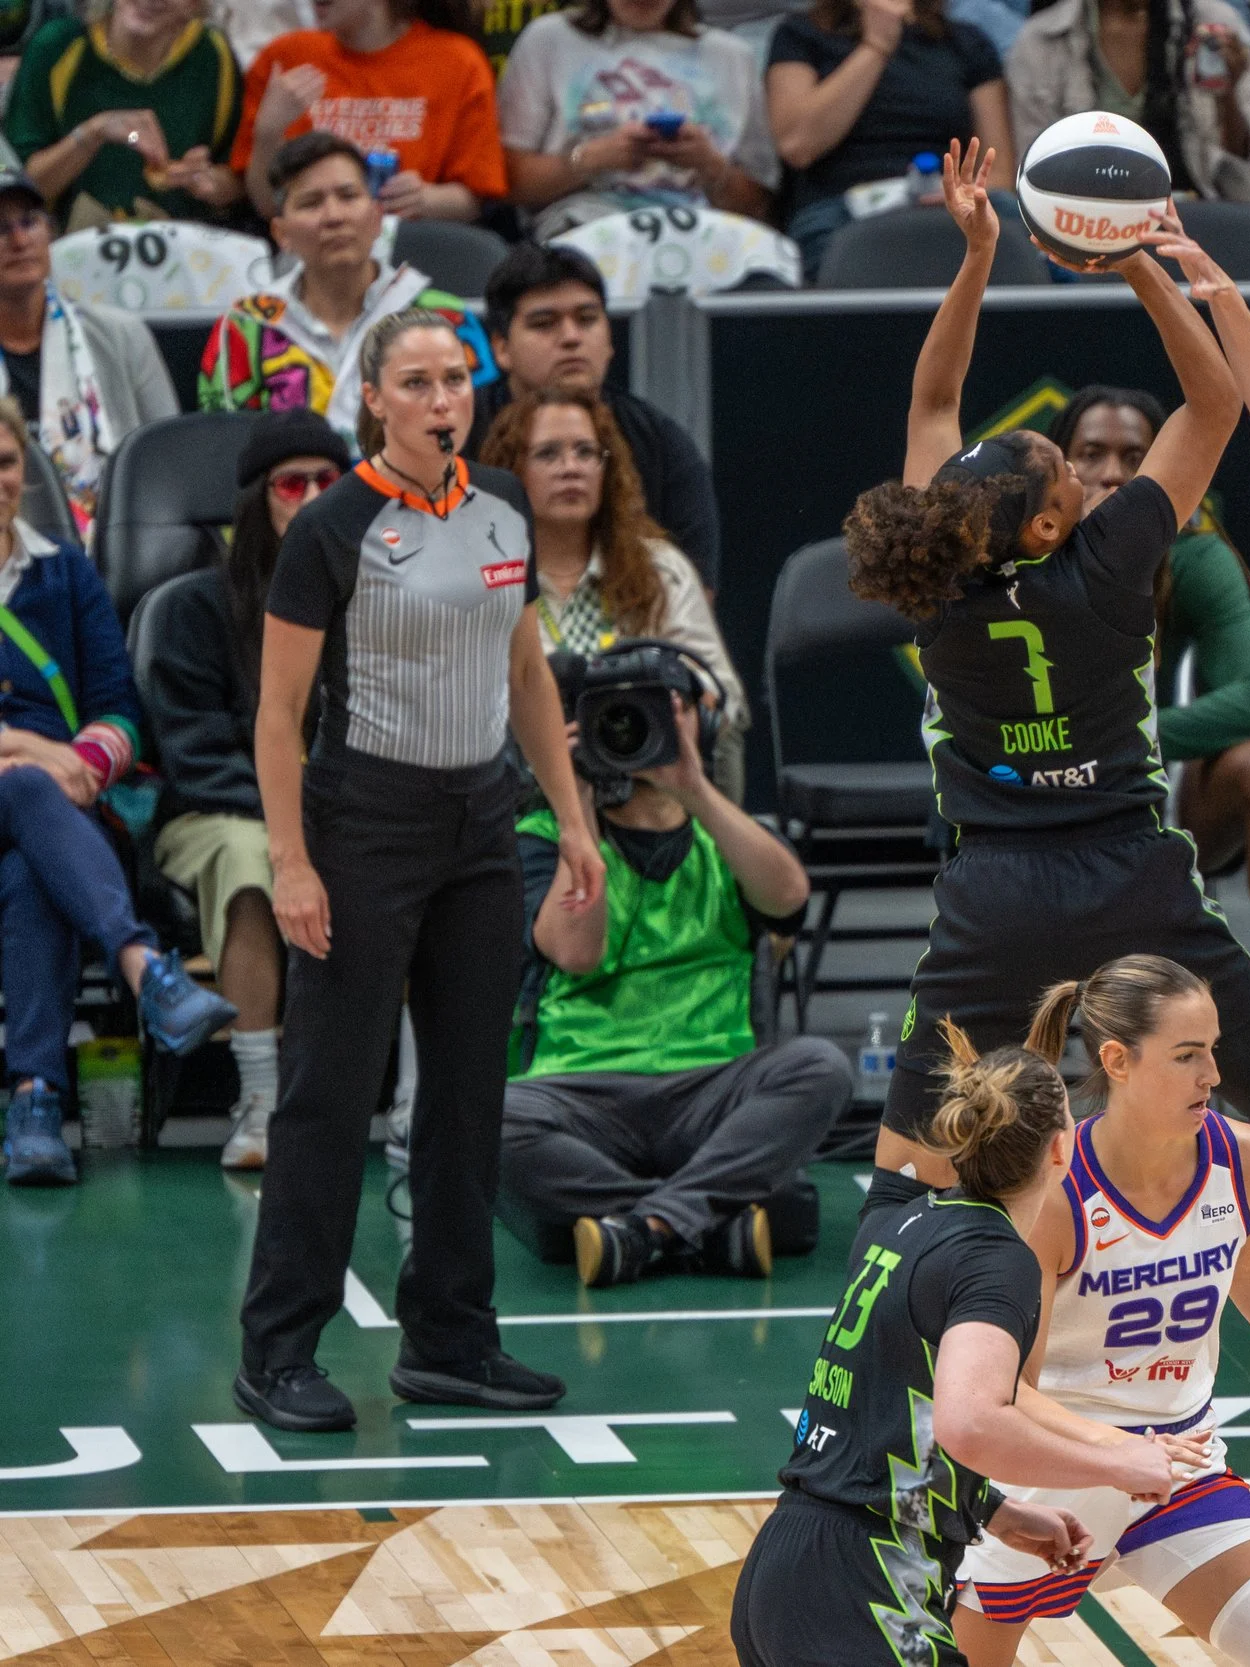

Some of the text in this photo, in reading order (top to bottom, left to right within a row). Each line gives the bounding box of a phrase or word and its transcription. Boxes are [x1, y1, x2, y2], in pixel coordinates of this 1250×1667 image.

[630, 206, 697, 242] 90
[1054, 206, 1151, 241] Wilson
[101, 231, 167, 274] 90
[987, 619, 1055, 714] 7
[1000, 716, 1073, 755] COOKE
[1030, 759, 1099, 789] AT&T
[1201, 1203, 1235, 1219] HERO
[1077, 1236, 1240, 1298] MERCURY
[1103, 1284, 1220, 1348] 29
